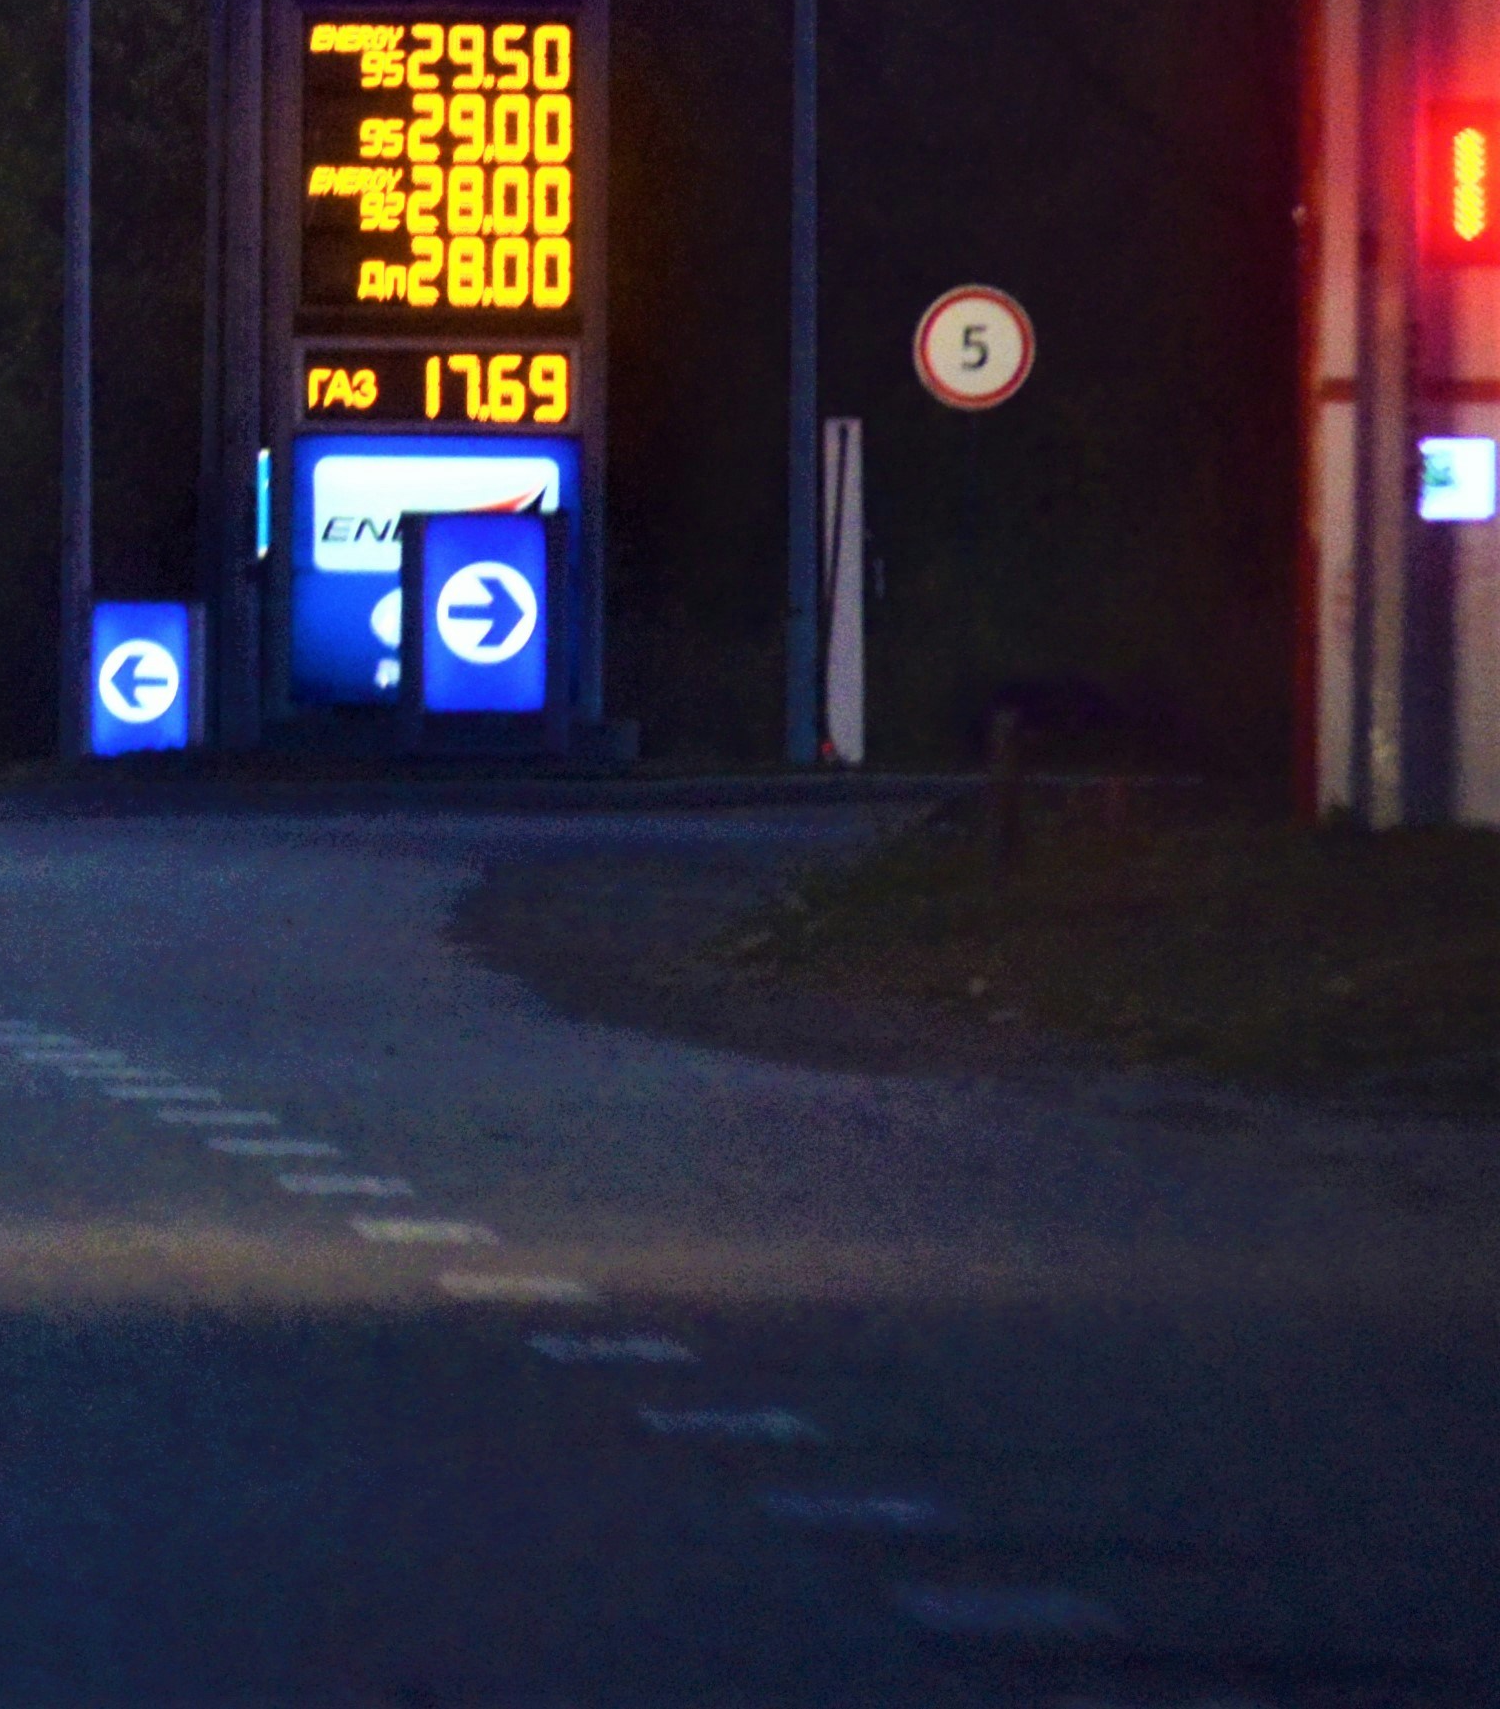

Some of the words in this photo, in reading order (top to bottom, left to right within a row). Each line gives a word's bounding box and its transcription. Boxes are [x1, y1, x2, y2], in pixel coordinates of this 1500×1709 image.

[309, 23, 404, 52] ENERGY
[360, 50, 405, 89] 95
[359, 118, 405, 159] 95
[308, 165, 403, 196] ENERGY
[360, 191, 405, 231] 92
[961, 323, 989, 371] 5
[308, 367, 379, 410] ГАЗ
